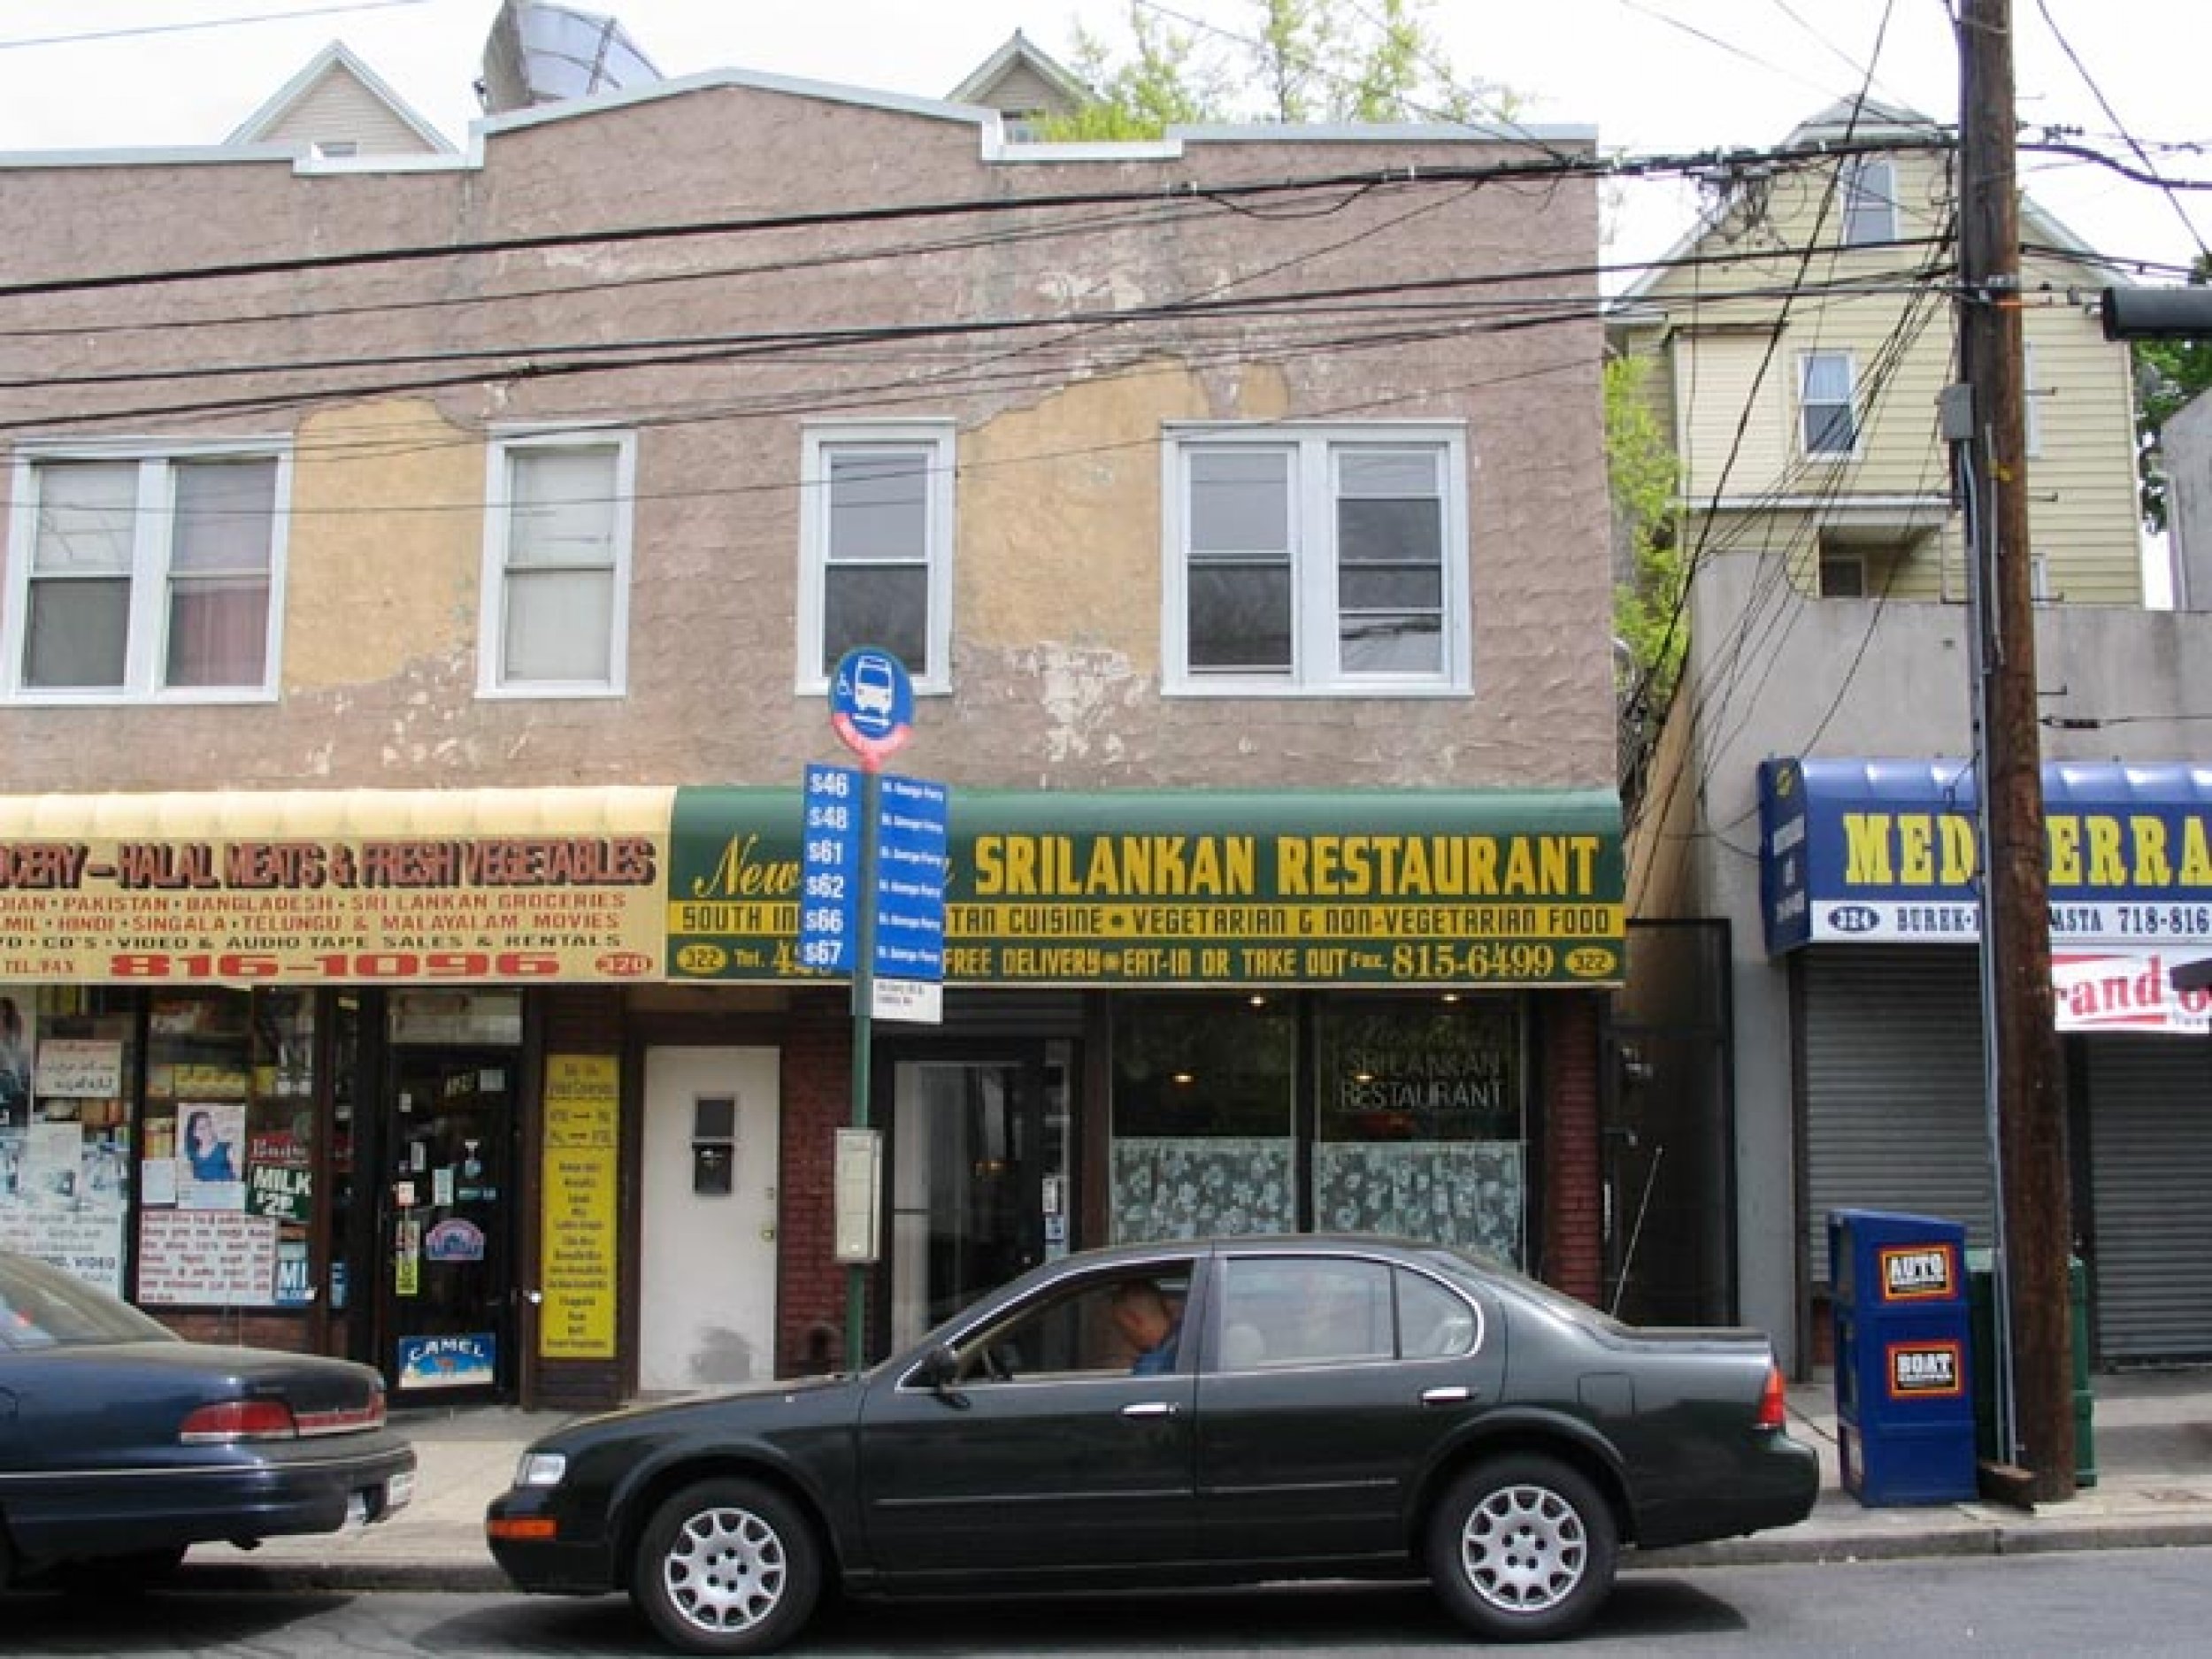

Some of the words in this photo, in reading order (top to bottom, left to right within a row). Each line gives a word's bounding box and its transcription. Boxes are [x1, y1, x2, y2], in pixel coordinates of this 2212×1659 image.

[118, 842, 221, 889] HALAL
[223, 842, 327, 889] MEATS
[328, 842, 357, 889] &
[361, 841, 461, 889] FRESH
[464, 837, 657, 888] VEGETABLES
[693, 833, 802, 898] New
[975, 835, 1255, 895] SRILANKAN
[1278, 835, 1599, 895] RESTAURANT
[63, 895, 169, 911] PAKISTAN
[186, 895, 333, 911] BANGLADESH
[351, 895, 388, 910] SRI
[397, 894, 488, 910] LANKAN
[497, 893, 626, 910] GROCERIES
[58, 915, 115, 932] HINDI
[133, 915, 227, 932] SINGALA
[242, 914, 342, 932] TELUNGU
[354, 914, 369, 931] &
[380, 913, 518, 931] MALAYALAM
[534, 912, 620, 930] MOVIES
[682, 905, 762, 932] SOUTH
[1010, 906, 1102, 932] CUISINE
[1132, 908, 1286, 934] VEGETARIAN
[1325, 908, 1536, 934] NON-VEGETARIAN
[1548, 908, 1609, 934] FOOD
[117, 936, 188, 949] VIDEO
[199, 936, 215, 949] &
[226, 935, 301, 949] AUDIO
[311, 935, 369, 949] TAPE
[382, 935, 464, 949] SALES
[477, 934, 493, 948] &
[504, 934, 621, 948] RENTALS
[109, 954, 561, 978] 816-1096
[945, 948, 992, 974] FREE
[1002, 949, 1101, 975] DELIVERY
[1202, 949, 1231, 977] OR
[1243, 949, 1297, 977] TAKE
[1305, 949, 1348, 977] OUT
[1393, 942, 1555, 979] 815-6499
[1573, 952, 1608, 972] 322
[253, 1165, 312, 1198] MILK
[410, 1337, 485, 1361] CAMEL
